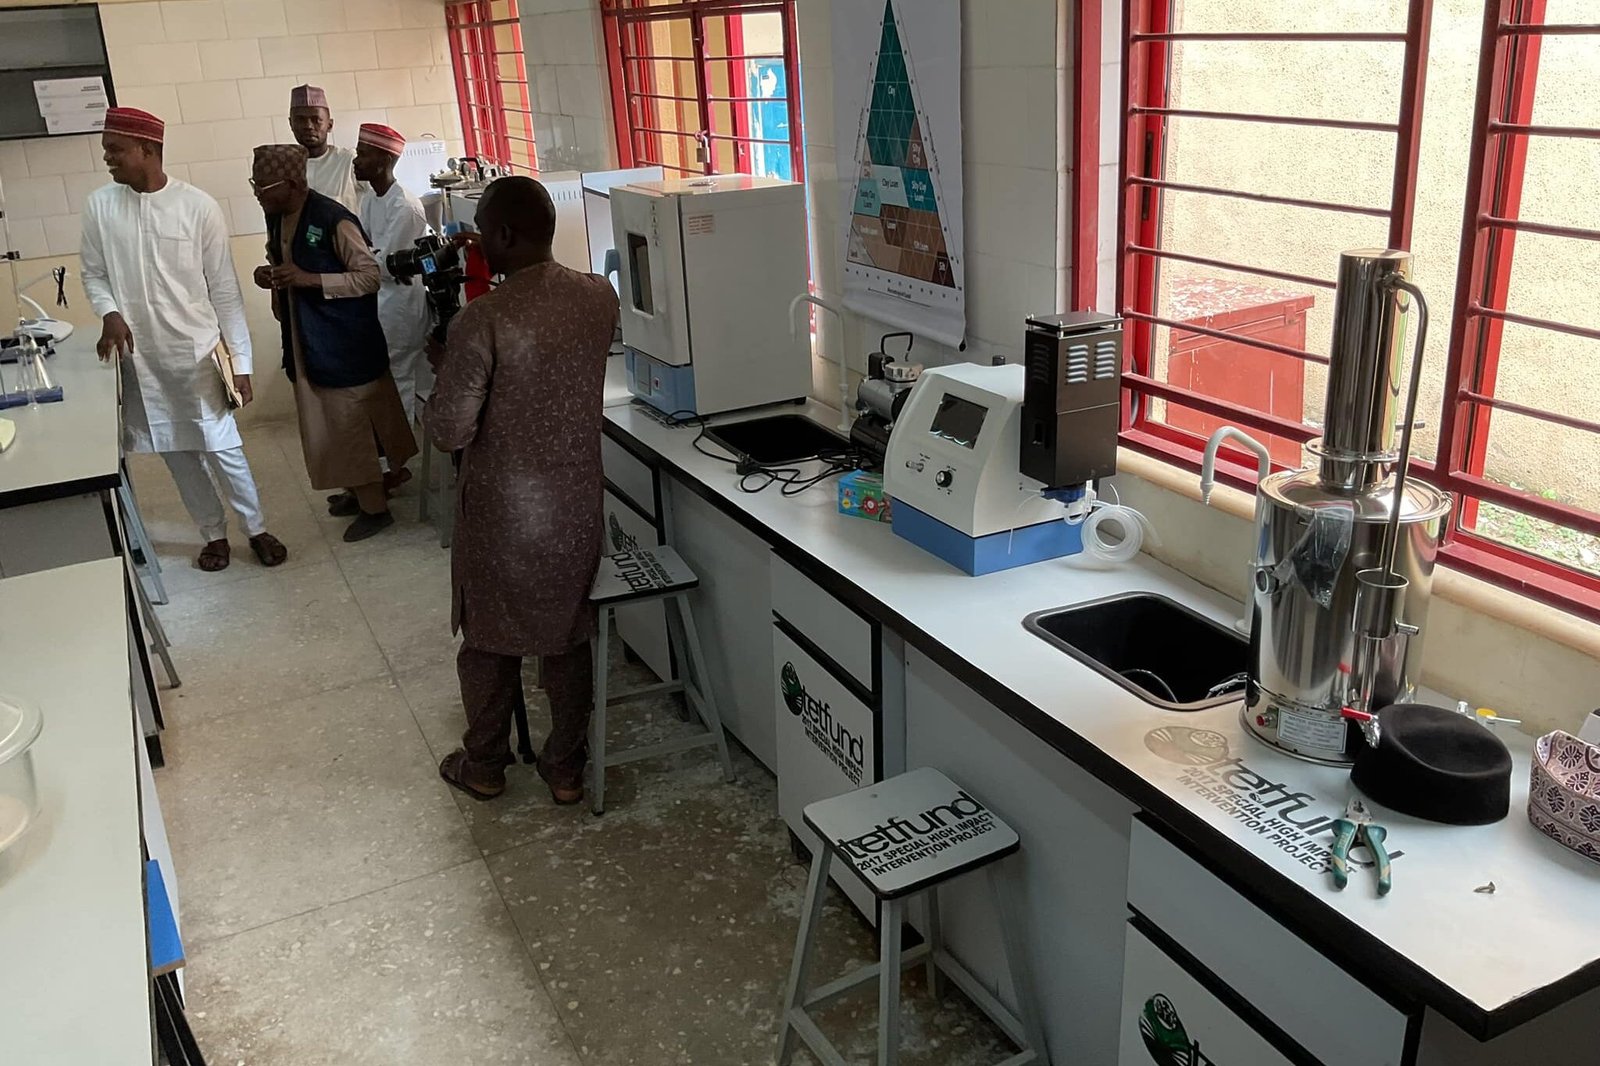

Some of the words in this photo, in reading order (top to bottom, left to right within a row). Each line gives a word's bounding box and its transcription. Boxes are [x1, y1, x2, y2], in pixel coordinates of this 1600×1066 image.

[881, 178, 890, 189] Clay
[801, 685, 864, 769] tetfund
[837, 791, 985, 859] tetfund
[857, 855, 885, 871] 2017
[883, 838, 932, 860] SPECIAL
[929, 827, 956, 843] HIGH
[955, 812, 994, 832] IMPACT
[871, 840, 951, 876] INTERVENTION
[950, 822, 997, 845] PROJECT
[1176, 775, 1272, 835] INTERVENTION
[1265, 834, 1333, 874] PROJECT
[1182, 767, 1218, 785] 2017
[1212, 783, 1266, 819] SPECIAL
[1264, 817, 1304, 841] HIGH
[1301, 840, 1357, 874] IMPAT
